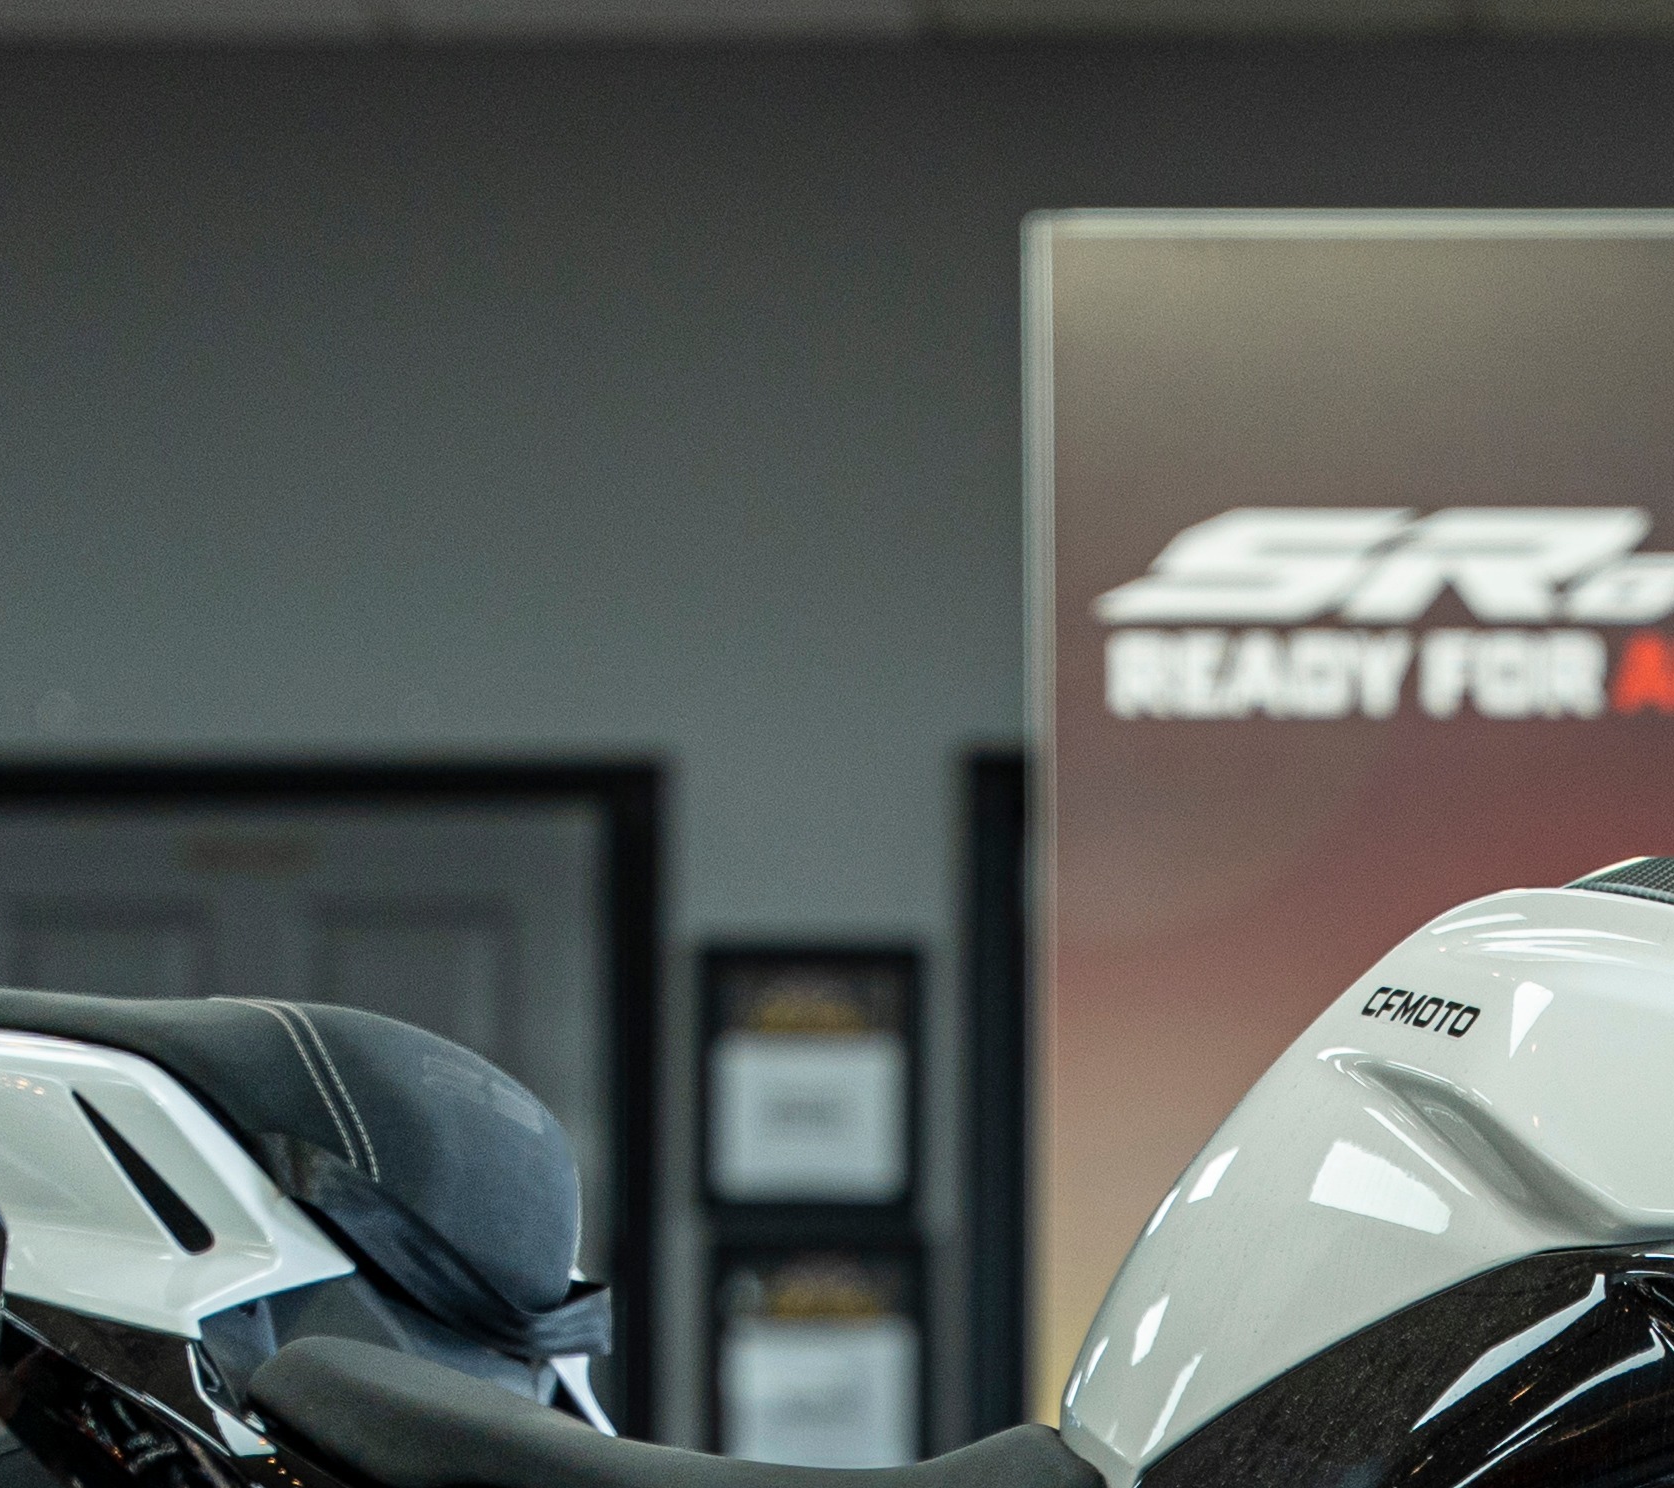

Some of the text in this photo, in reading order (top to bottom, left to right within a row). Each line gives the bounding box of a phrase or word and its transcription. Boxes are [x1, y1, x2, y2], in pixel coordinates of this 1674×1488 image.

[1095, 507, 1649, 625] SR
[1106, 628, 1411, 719] READY
[1418, 628, 1607, 719] FOR
[1361, 986, 1481, 1038] CFMOTO
